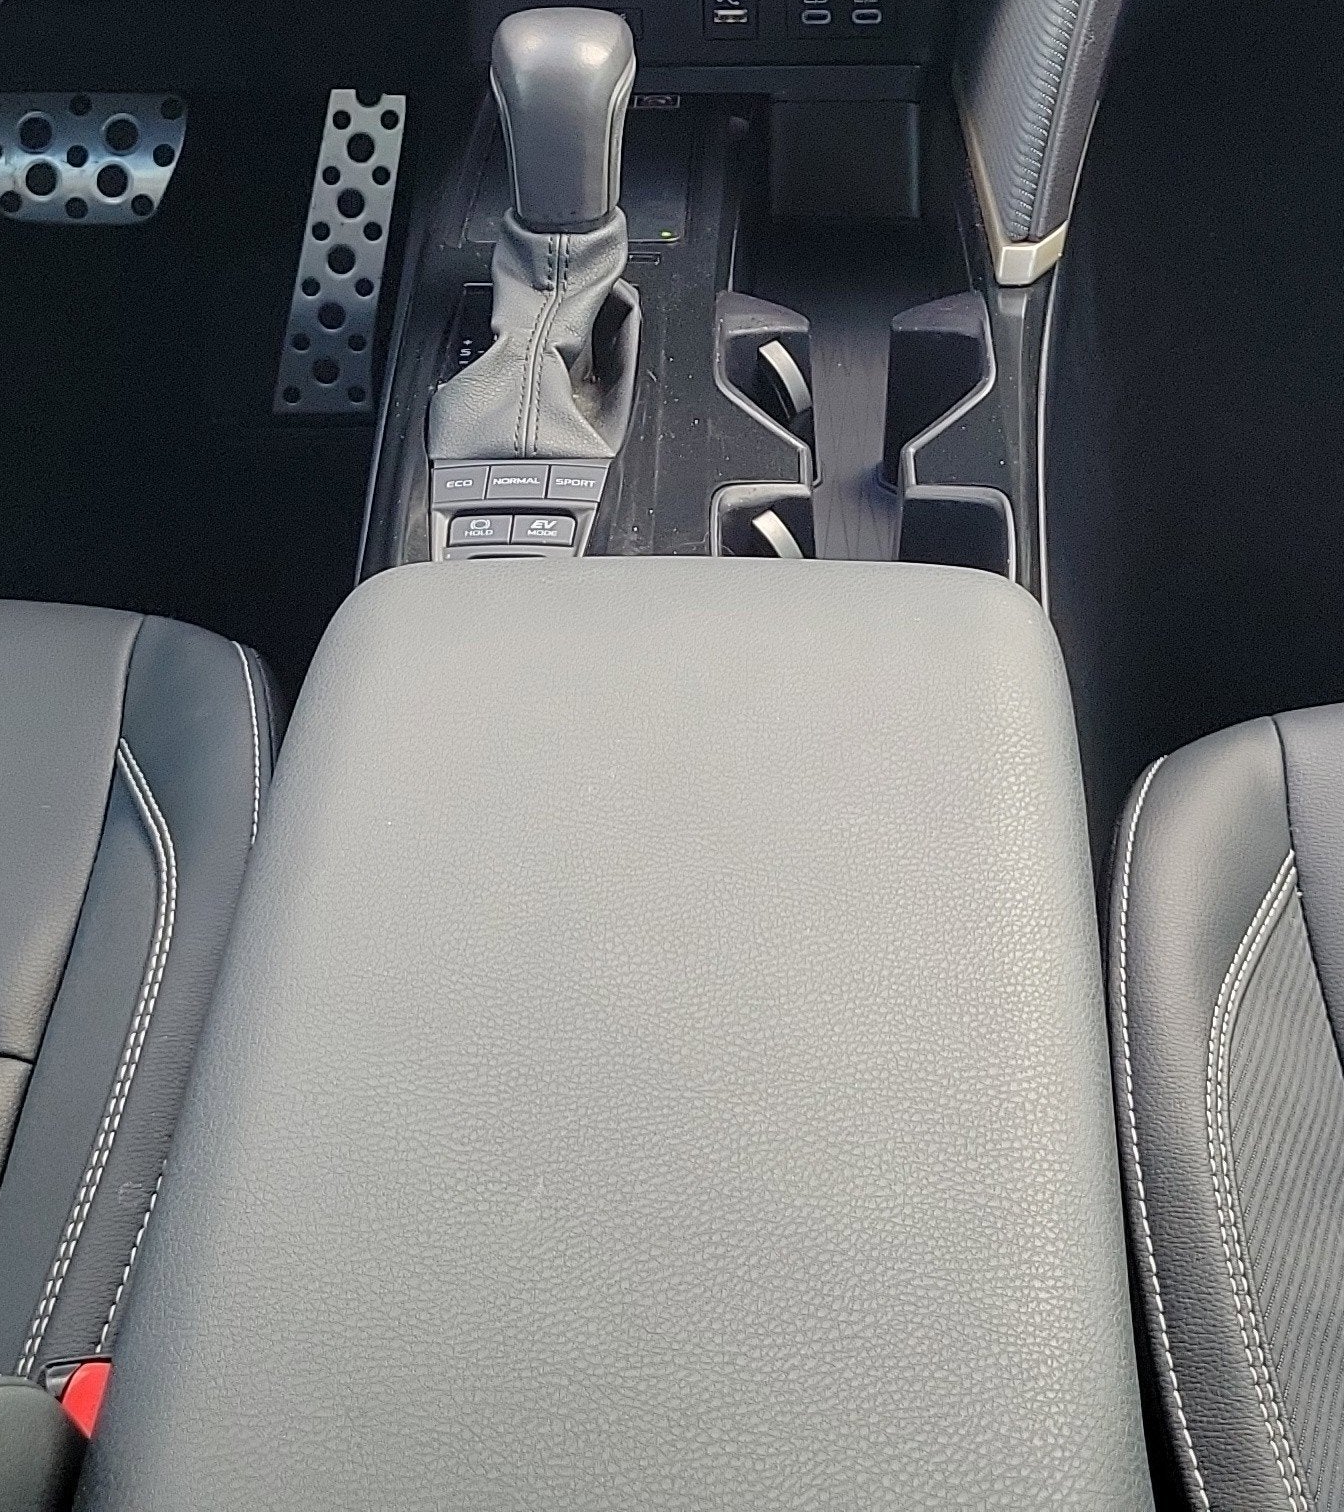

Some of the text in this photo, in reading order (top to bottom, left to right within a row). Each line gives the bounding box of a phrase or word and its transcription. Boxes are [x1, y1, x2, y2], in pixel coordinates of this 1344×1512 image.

[446, 479, 473, 488] ECO
[555, 478, 596, 488] SPORT
[530, 520, 558, 529] EV
[464, 530, 494, 538] HOLD
